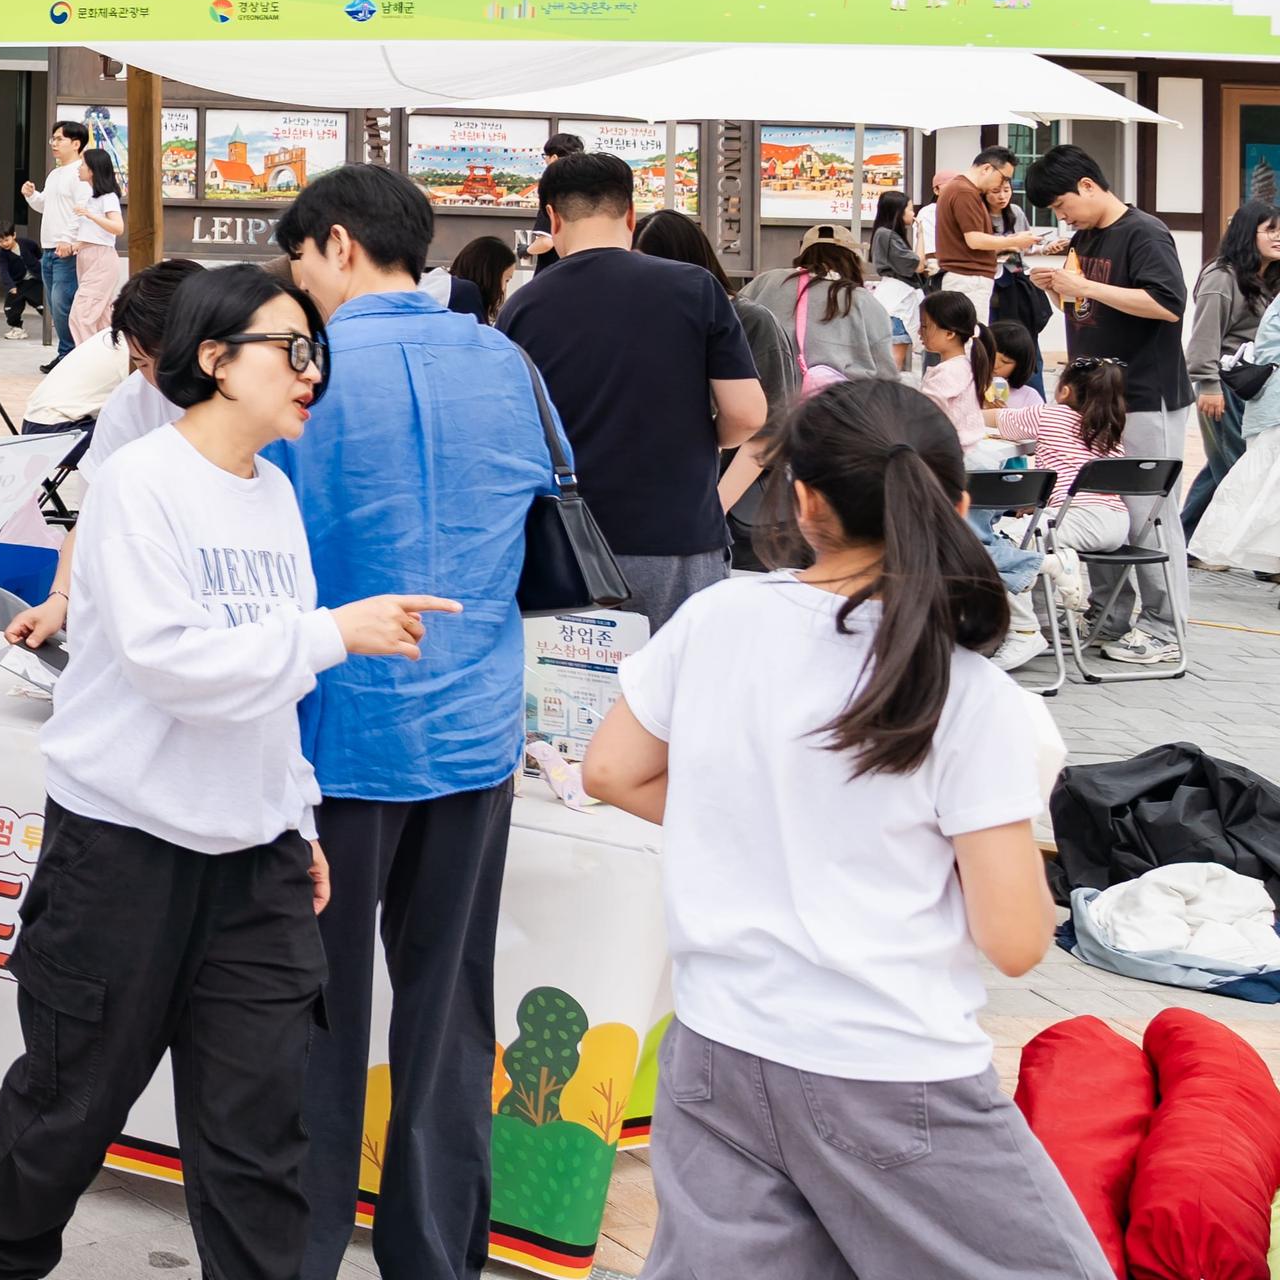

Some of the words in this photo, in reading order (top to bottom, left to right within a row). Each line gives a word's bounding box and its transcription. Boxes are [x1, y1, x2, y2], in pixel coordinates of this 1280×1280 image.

[77, 6, 150, 20] 문화체육관광부
[238, 1, 280, 13] 경상남도
[381, 1, 415, 14] 남해군
[559, 624, 614, 648] 창업존
[536, 640, 591, 660] 부스참여
